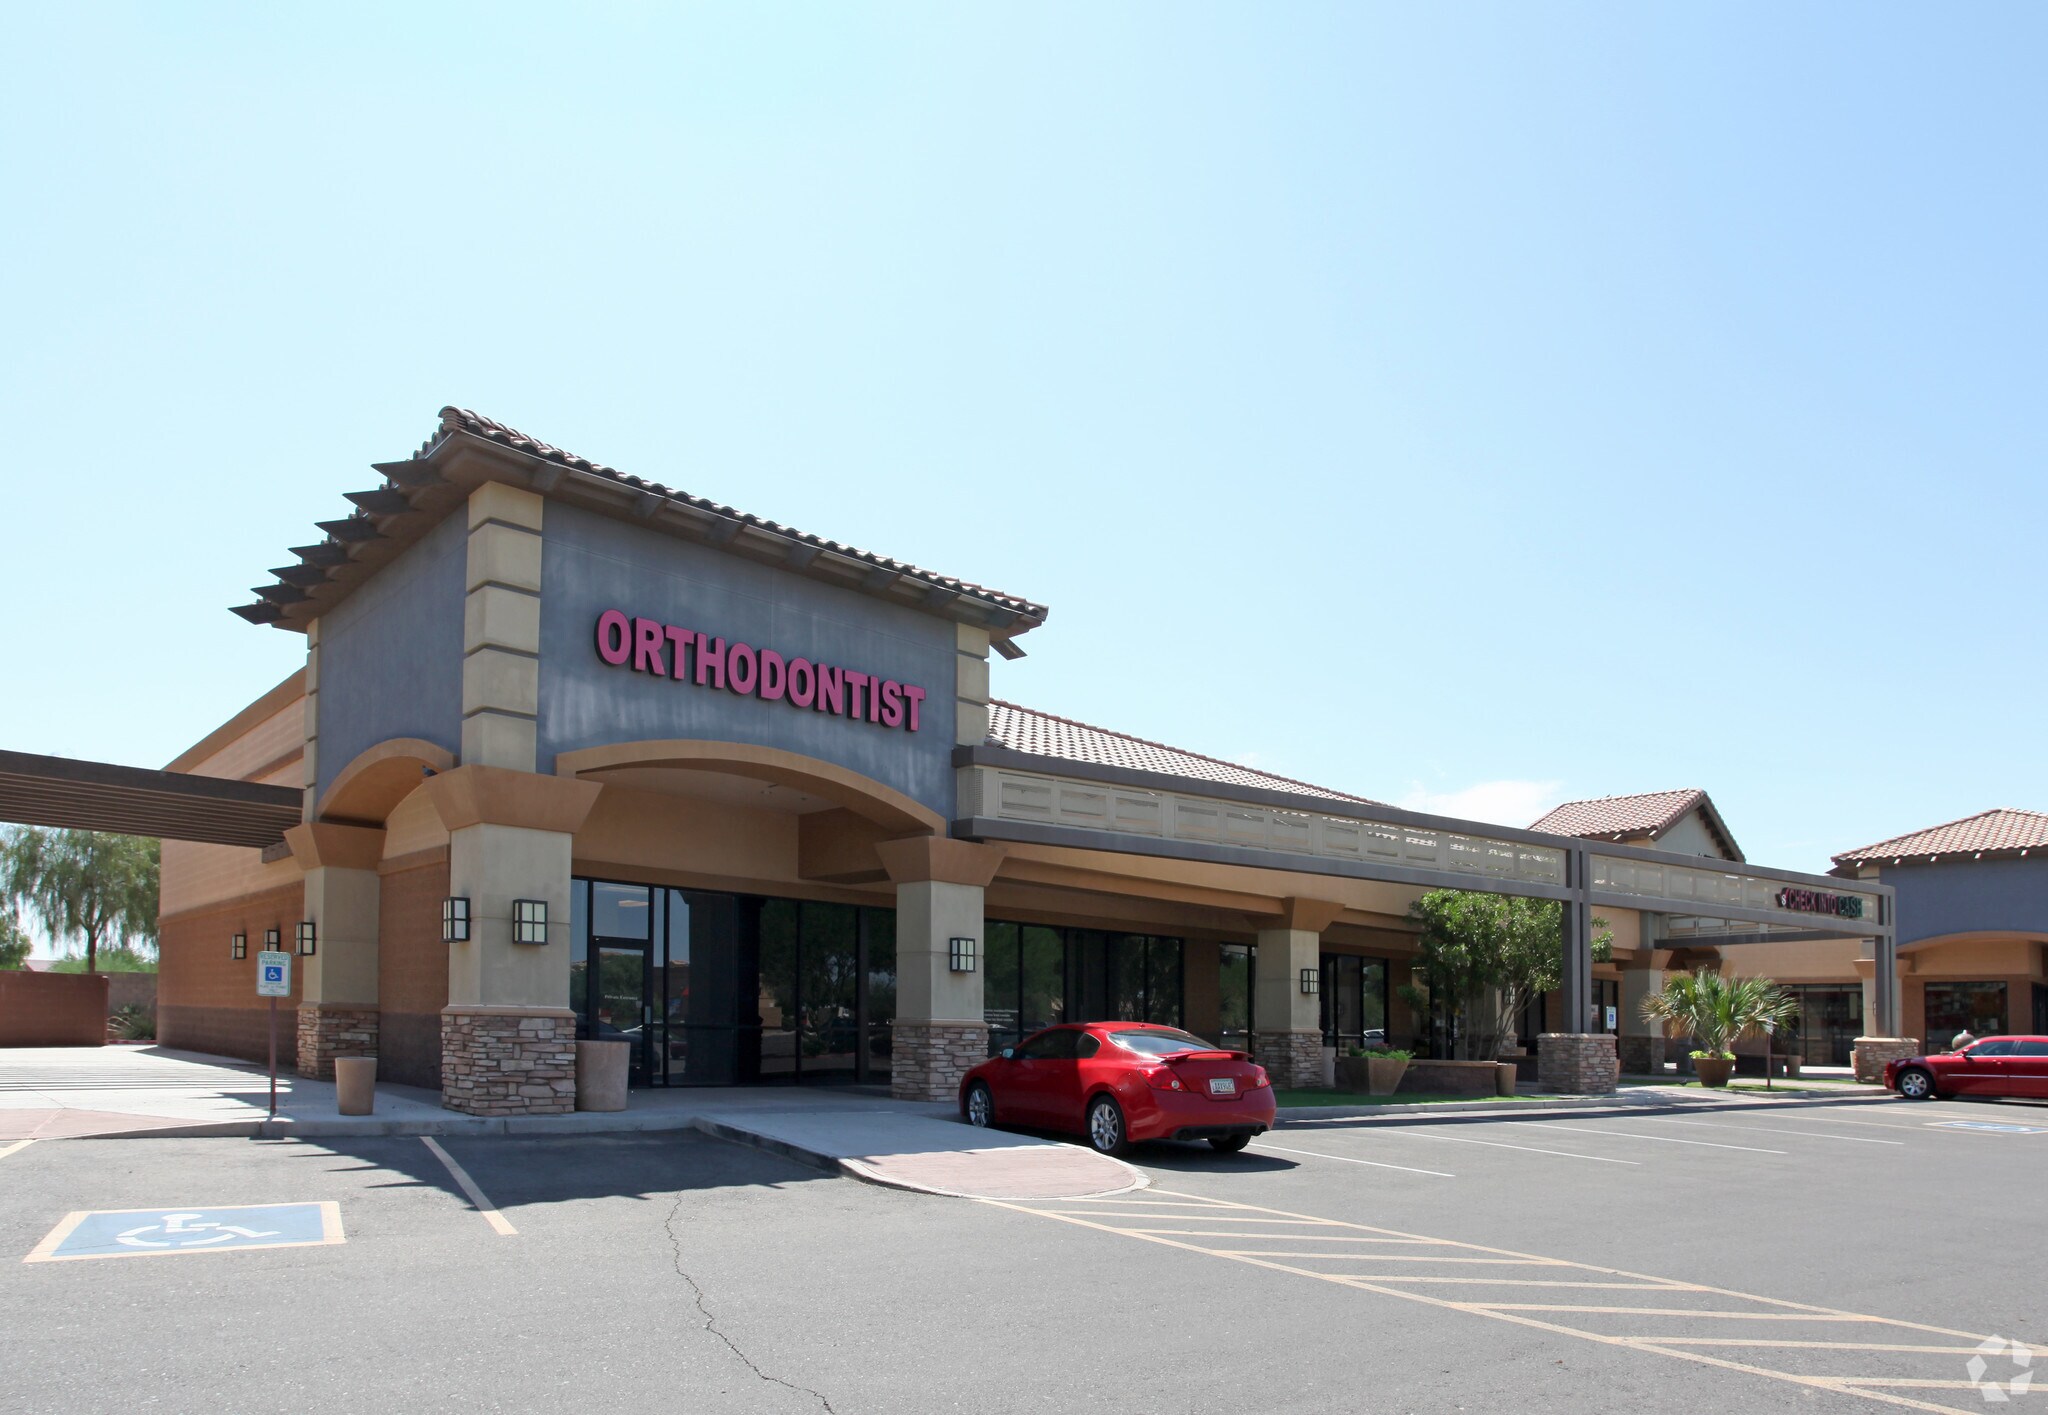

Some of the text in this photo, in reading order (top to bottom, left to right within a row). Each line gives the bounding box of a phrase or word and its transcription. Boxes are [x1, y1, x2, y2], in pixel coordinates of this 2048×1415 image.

[595, 609, 926, 732] ORTHODONTIST
[1789, 887, 1817, 912] CHECK
[1818, 892, 1837, 914] INTO
[1838, 896, 1863, 917] CASH
